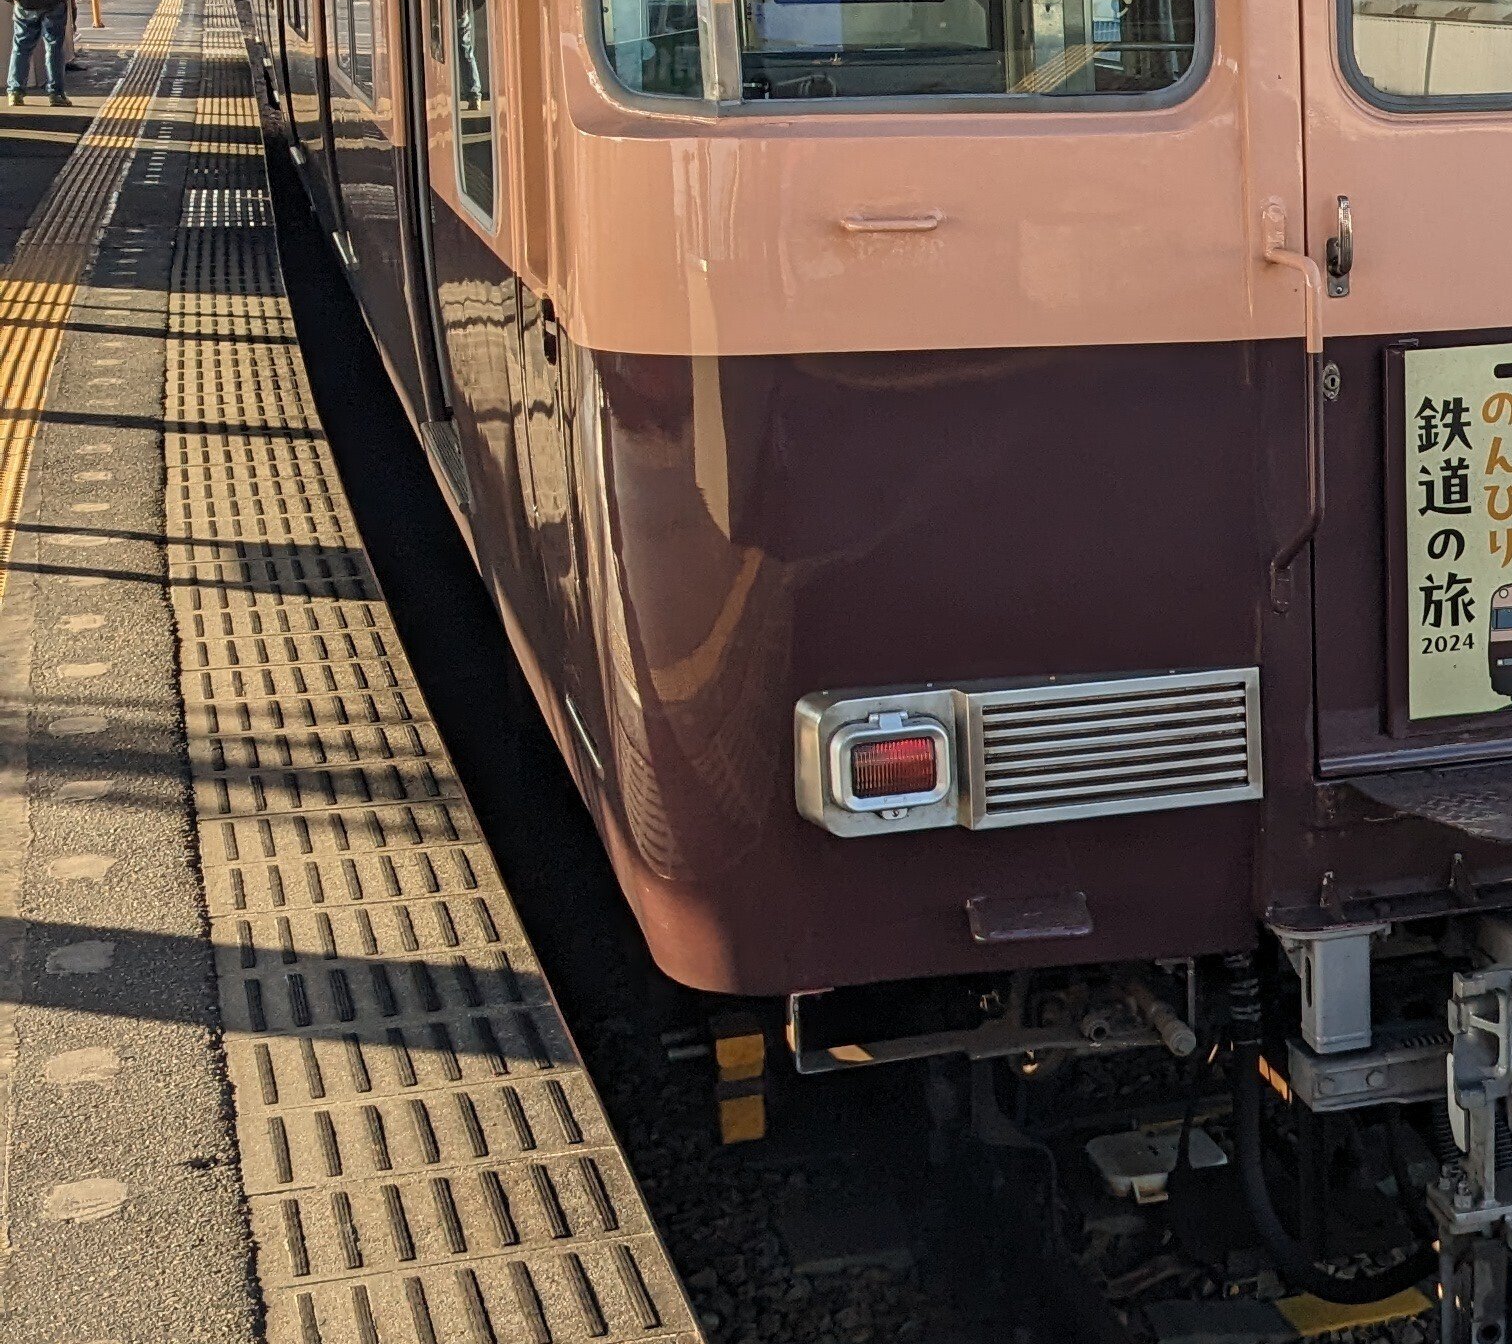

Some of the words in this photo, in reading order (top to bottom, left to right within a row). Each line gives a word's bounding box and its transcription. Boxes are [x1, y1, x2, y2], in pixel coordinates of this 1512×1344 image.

[1413, 395, 1477, 630] 鉄道の旅
[1421, 632, 1475, 655] 2024
